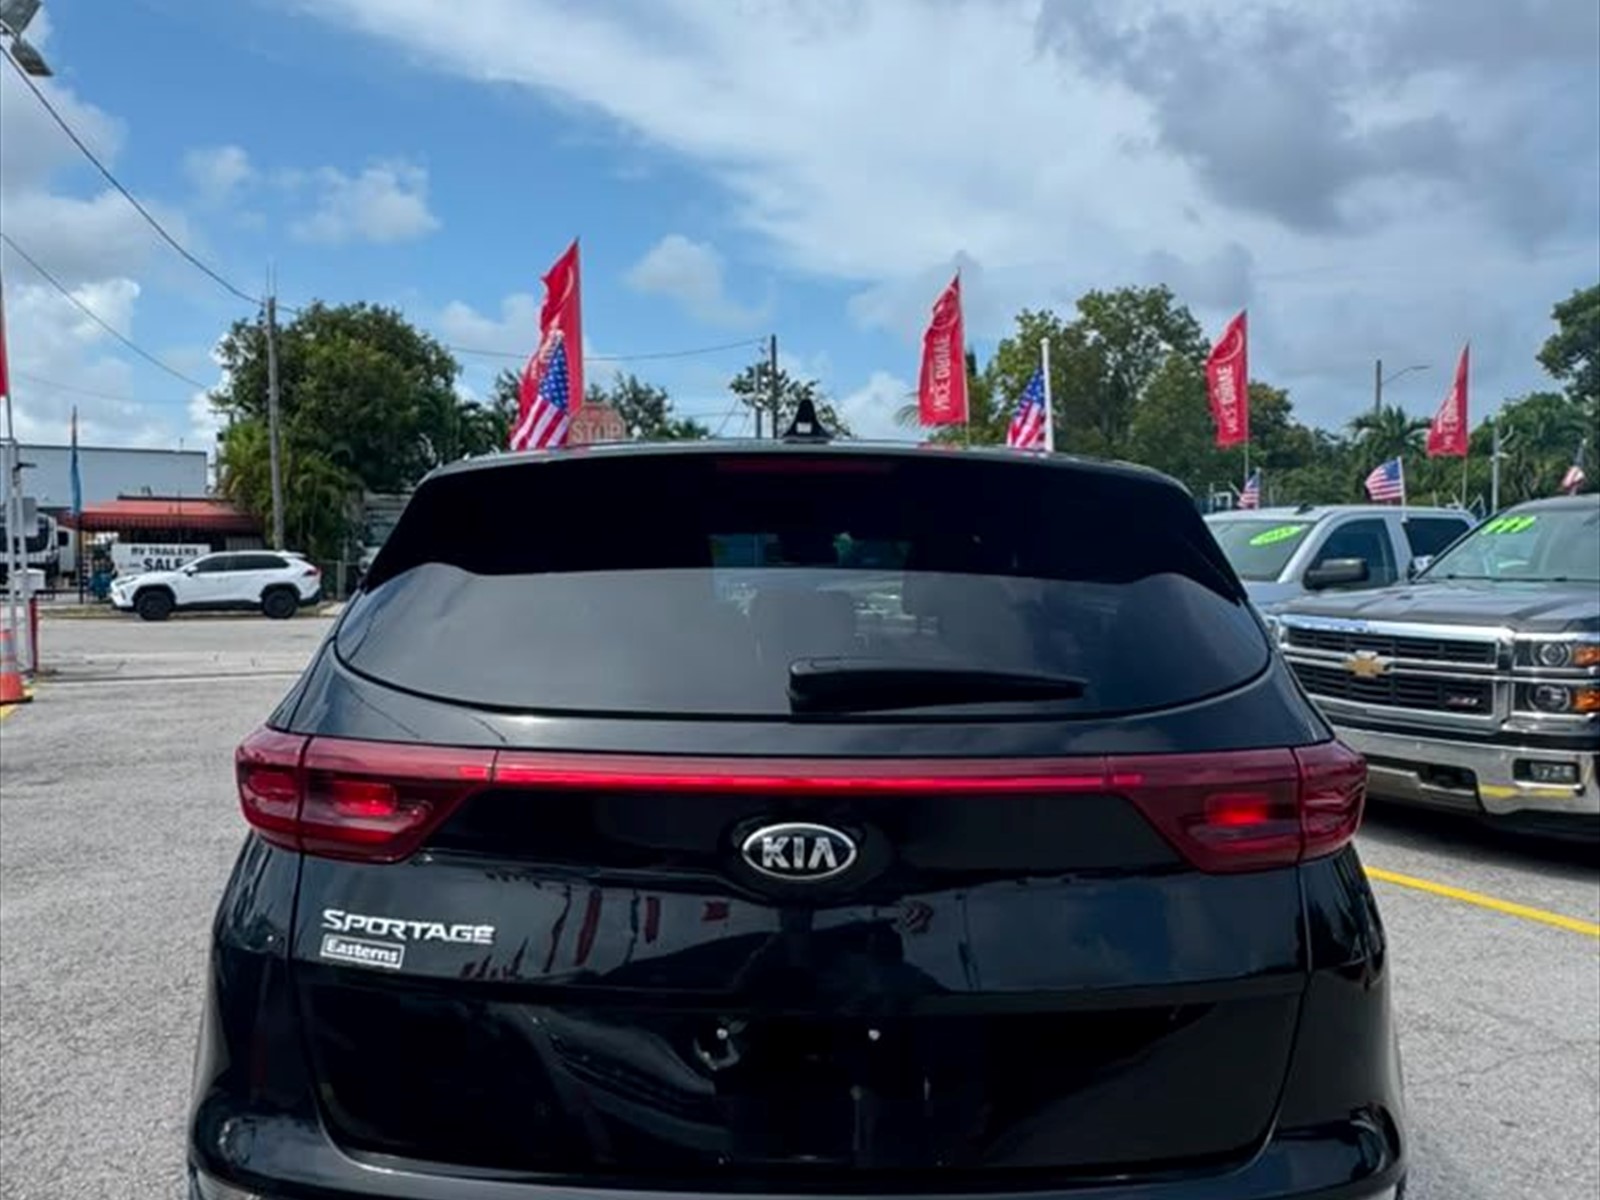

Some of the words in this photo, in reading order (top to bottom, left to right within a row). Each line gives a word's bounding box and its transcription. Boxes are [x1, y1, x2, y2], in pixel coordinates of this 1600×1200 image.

[572, 420, 621, 443] STOP
[148, 547, 199, 556] TRAILERS
[143, 558, 184, 572] SALE
[762, 836, 837, 869] KIA
[322, 908, 496, 944] SPORTAGE
[326, 938, 398, 962] Easterns
